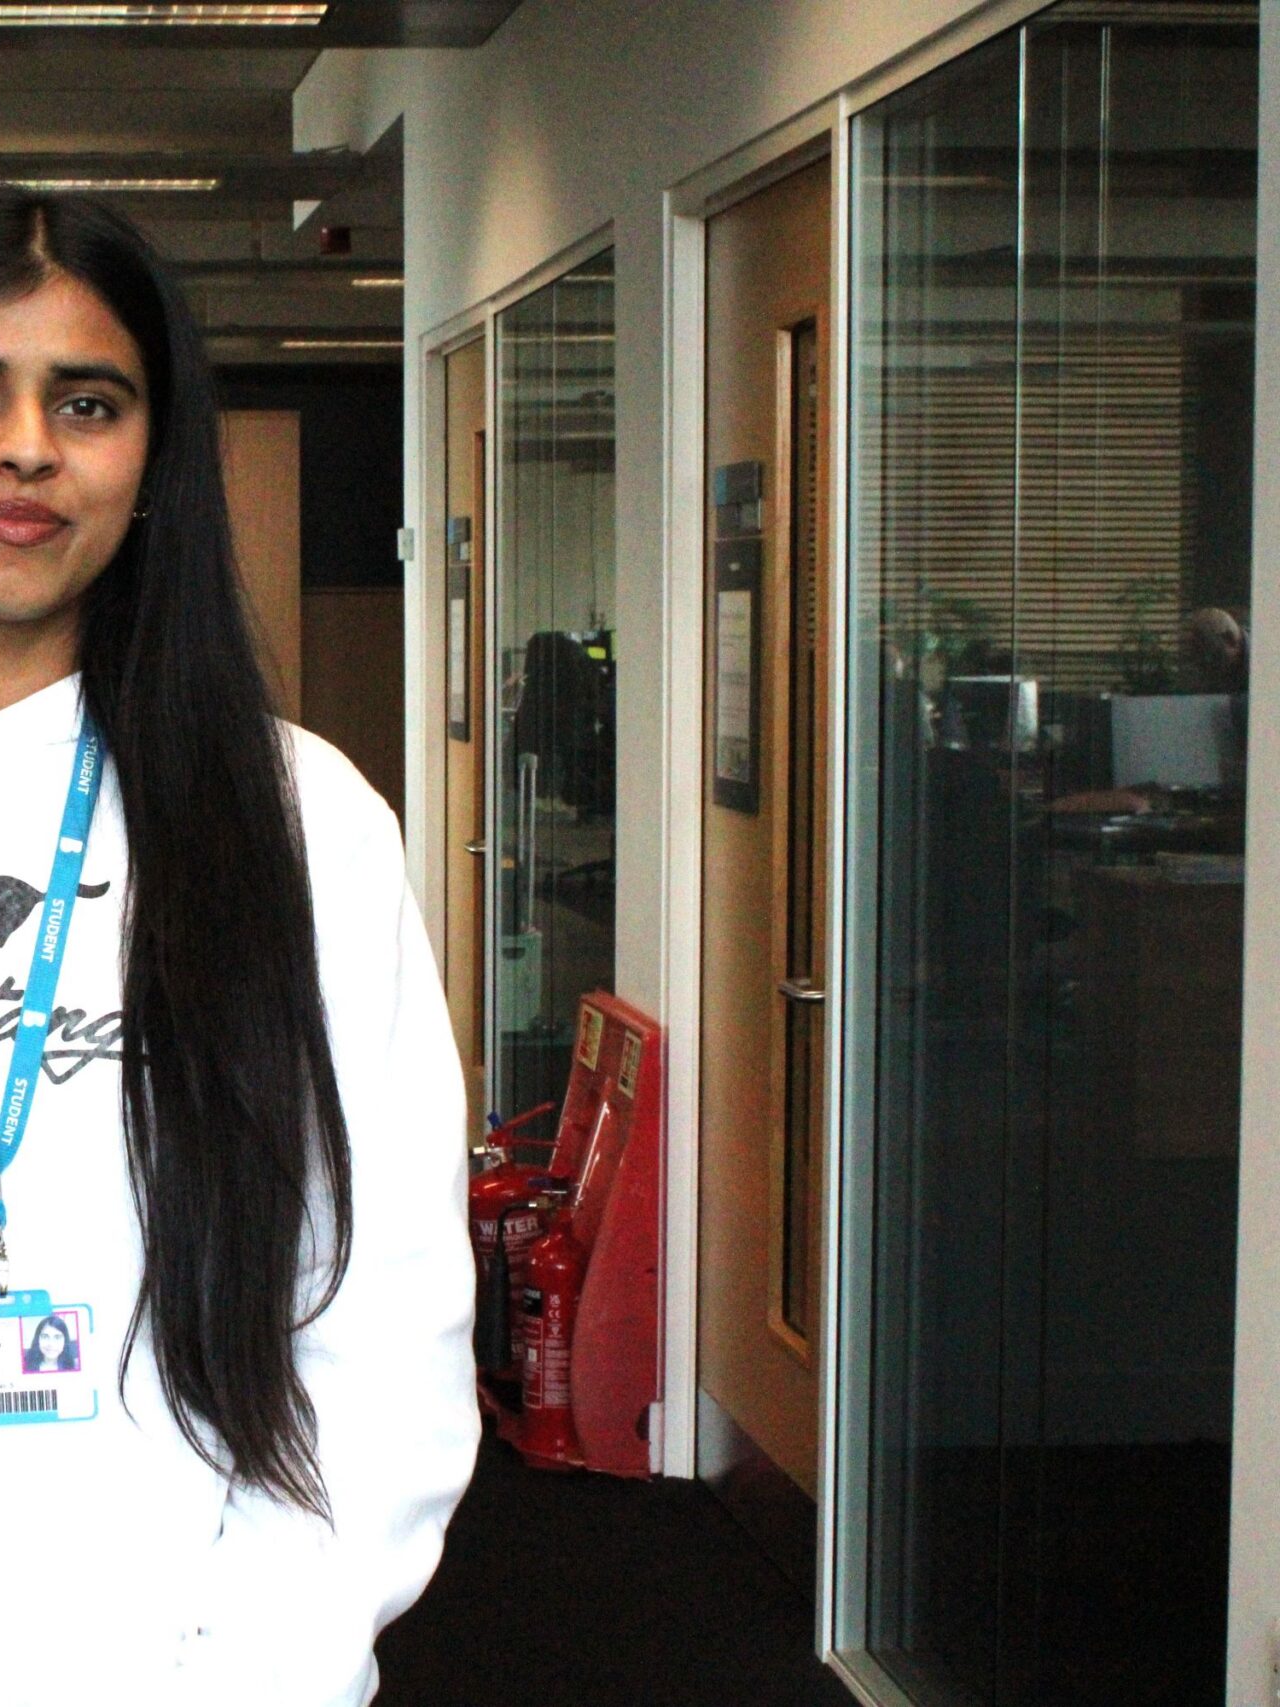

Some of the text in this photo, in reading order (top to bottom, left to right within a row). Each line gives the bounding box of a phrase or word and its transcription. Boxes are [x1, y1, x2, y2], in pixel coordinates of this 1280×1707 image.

[77, 737, 99, 795] STUDENT
[40, 897, 65, 964] STUDENT
[1, 1077, 28, 1146] STUDENT
[479, 1214, 539, 1236] WTER
